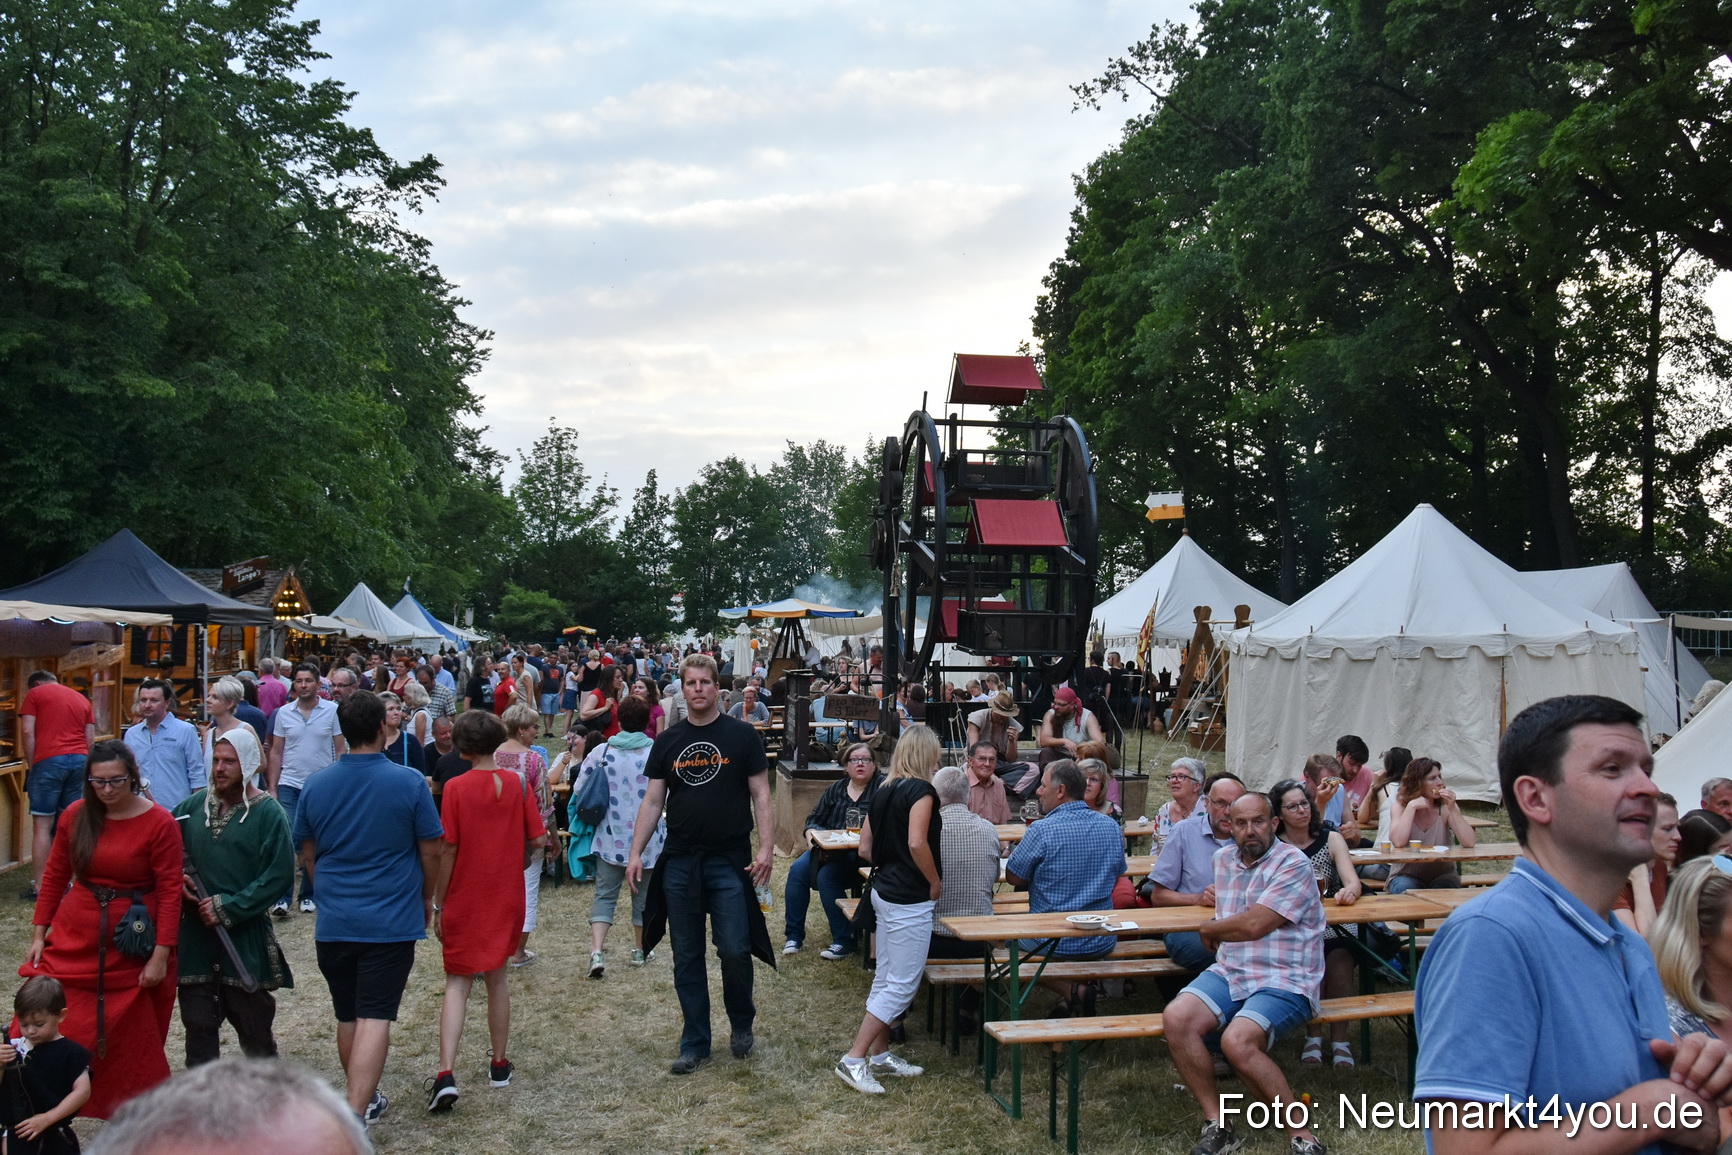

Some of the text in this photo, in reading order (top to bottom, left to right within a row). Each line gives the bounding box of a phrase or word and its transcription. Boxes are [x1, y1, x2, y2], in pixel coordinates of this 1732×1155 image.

[828, 698, 847, 710] pro
[835, 706, 842, 716] 3
[671, 752, 731, 772] Number One
